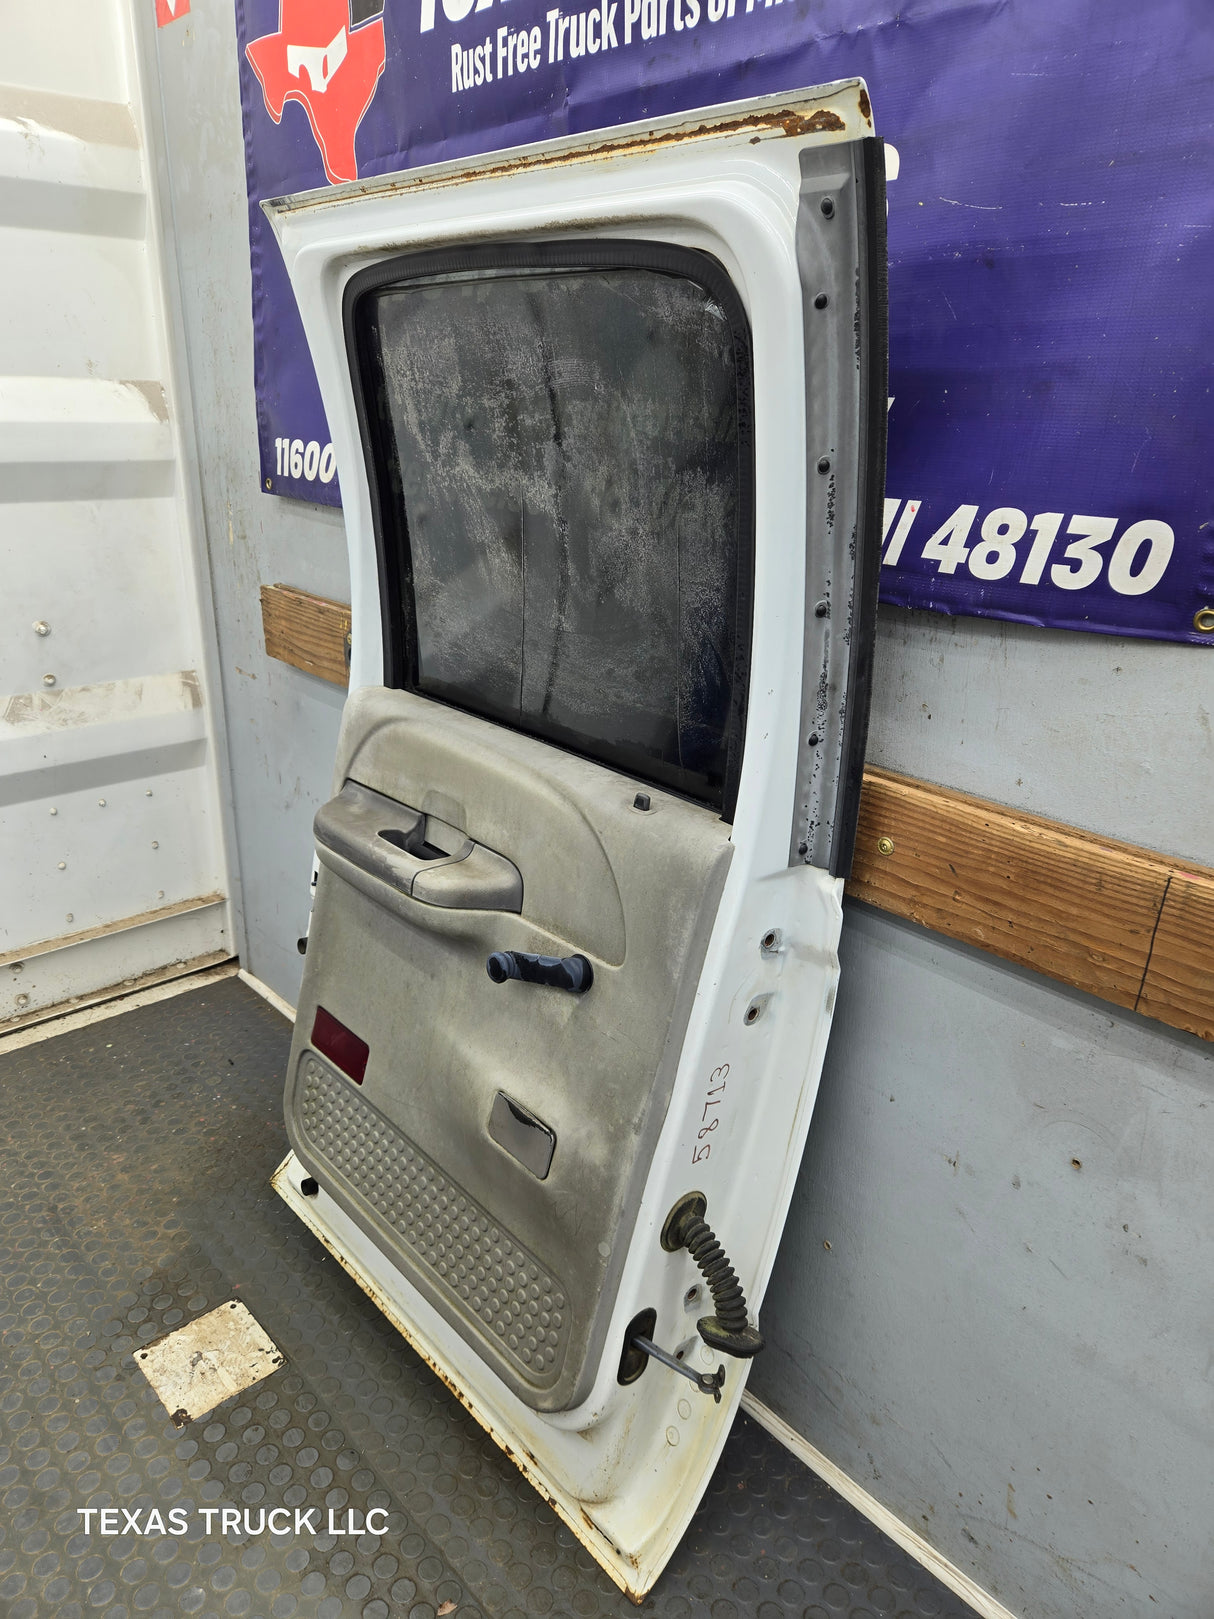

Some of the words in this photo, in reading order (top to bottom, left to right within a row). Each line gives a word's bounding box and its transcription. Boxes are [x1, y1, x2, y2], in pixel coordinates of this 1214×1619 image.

[451, 36, 493, 93] Rust
[496, 25, 542, 79] Free
[546, 0, 619, 64] Truck
[624, 0, 701, 45] Parts
[275, 437, 337, 483] 11600
[921, 504, 1175, 595] 48130
[692, 1063, 730, 1164] 58713
